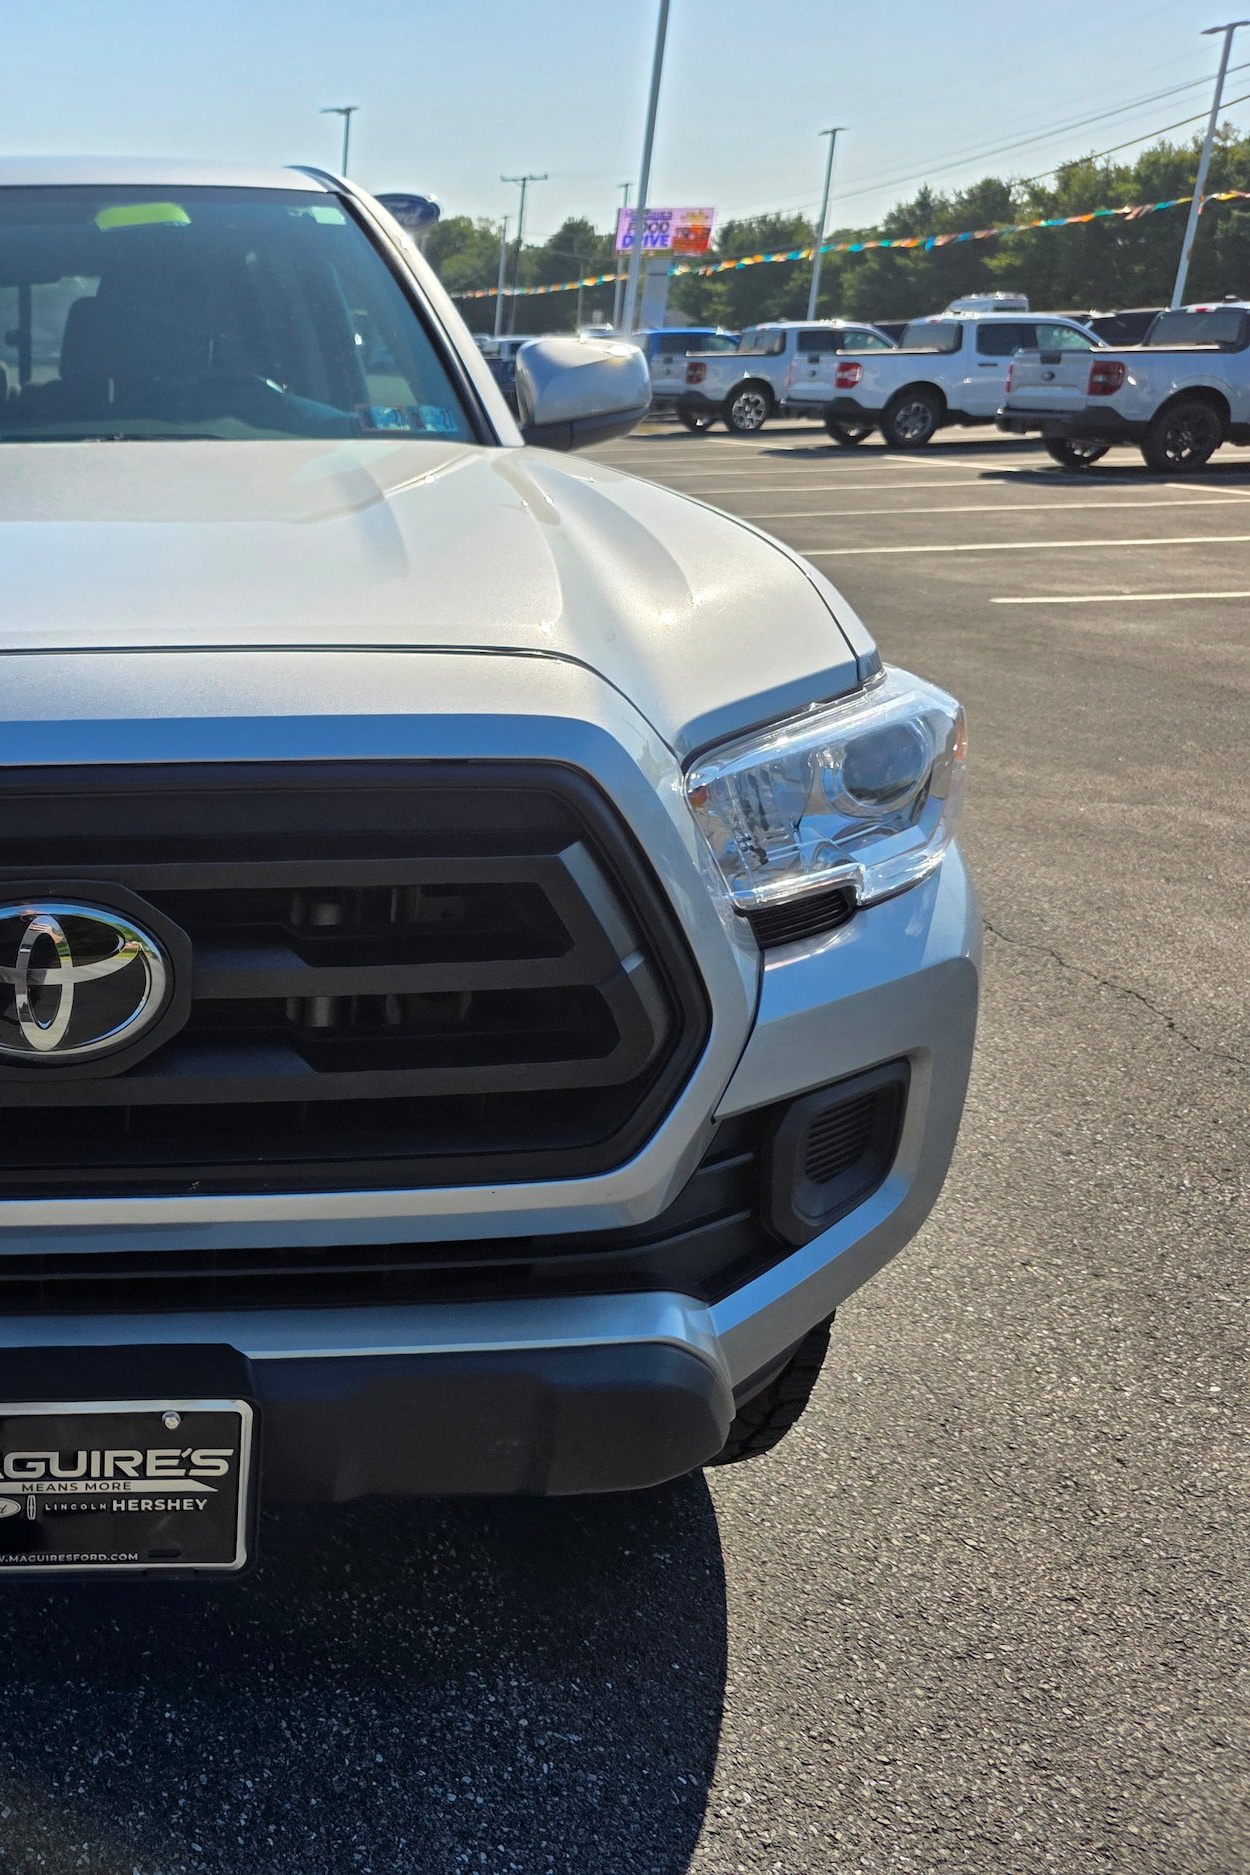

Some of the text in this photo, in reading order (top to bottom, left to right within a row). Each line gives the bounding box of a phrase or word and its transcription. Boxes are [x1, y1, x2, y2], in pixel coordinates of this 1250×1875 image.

[622, 234, 670, 248] DIVE
[21, 1481, 132, 1492] MEANS MORE
[44, 1498, 208, 1512] LINCOLN HERSHEY
